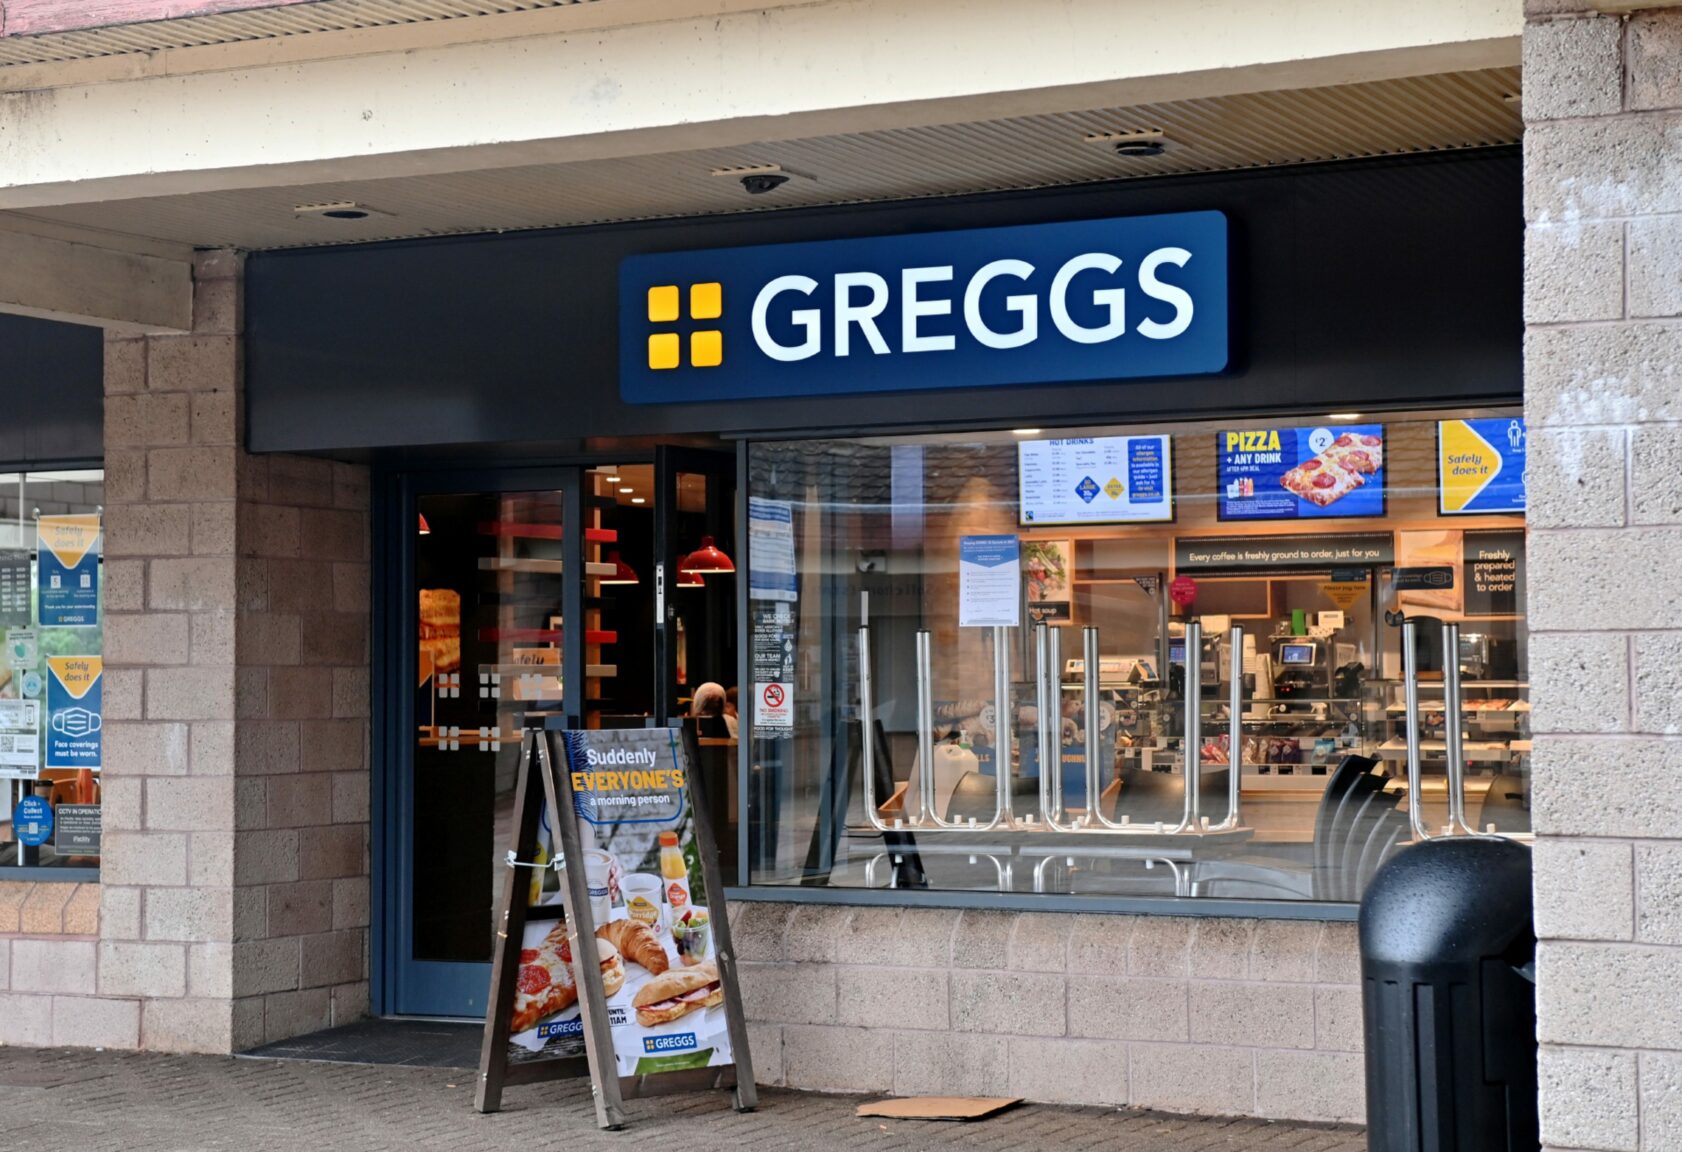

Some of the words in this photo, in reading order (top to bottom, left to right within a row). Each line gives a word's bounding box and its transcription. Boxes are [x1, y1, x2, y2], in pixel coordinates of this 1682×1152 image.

[751, 246, 1194, 362] GREGGS
[1226, 430, 1281, 452] PIZZA
[1234, 454, 1251, 464] ANY
[1255, 453, 1281, 464] DRINK
[1448, 453, 1482, 465] Safely
[1452, 466, 1477, 475] does
[1480, 465, 1488, 474] it
[55, 526, 83, 537] Safely
[55, 538, 76, 547] does
[1189, 552, 1210, 563] Every
[1212, 551, 1236, 561] coffee
[1237, 552, 1243, 560] is
[1245, 550, 1269, 561] freshly
[1271, 550, 1299, 561] ground
[1301, 550, 1309, 559] to
[1335, 549, 1350, 560] just
[1352, 548, 1363, 557] for
[1365, 549, 1379, 559] you
[1479, 550, 1510, 561] Freshly
[1474, 561, 1515, 572] prepared
[1474, 573, 1481, 581] &
[1484, 571, 1515, 581] heated
[1477, 582, 1486, 591] to
[1488, 582, 1513, 591] order
[64, 662, 89, 671] Safely
[64, 672, 84, 681] does
[84, 672, 90, 681] it
[69, 740, 98, 749] coverings
[586, 748, 656, 767] Suddenly
[571, 769, 685, 791] EVERYONE'S
[590, 798, 596, 806] a
[598, 795, 636, 806] morning
[638, 795, 670, 806] person
[610, 1016, 627, 1024] 11AM
[550, 1022, 583, 1035] GREGG
[655, 1035, 695, 1049] GREGGS
